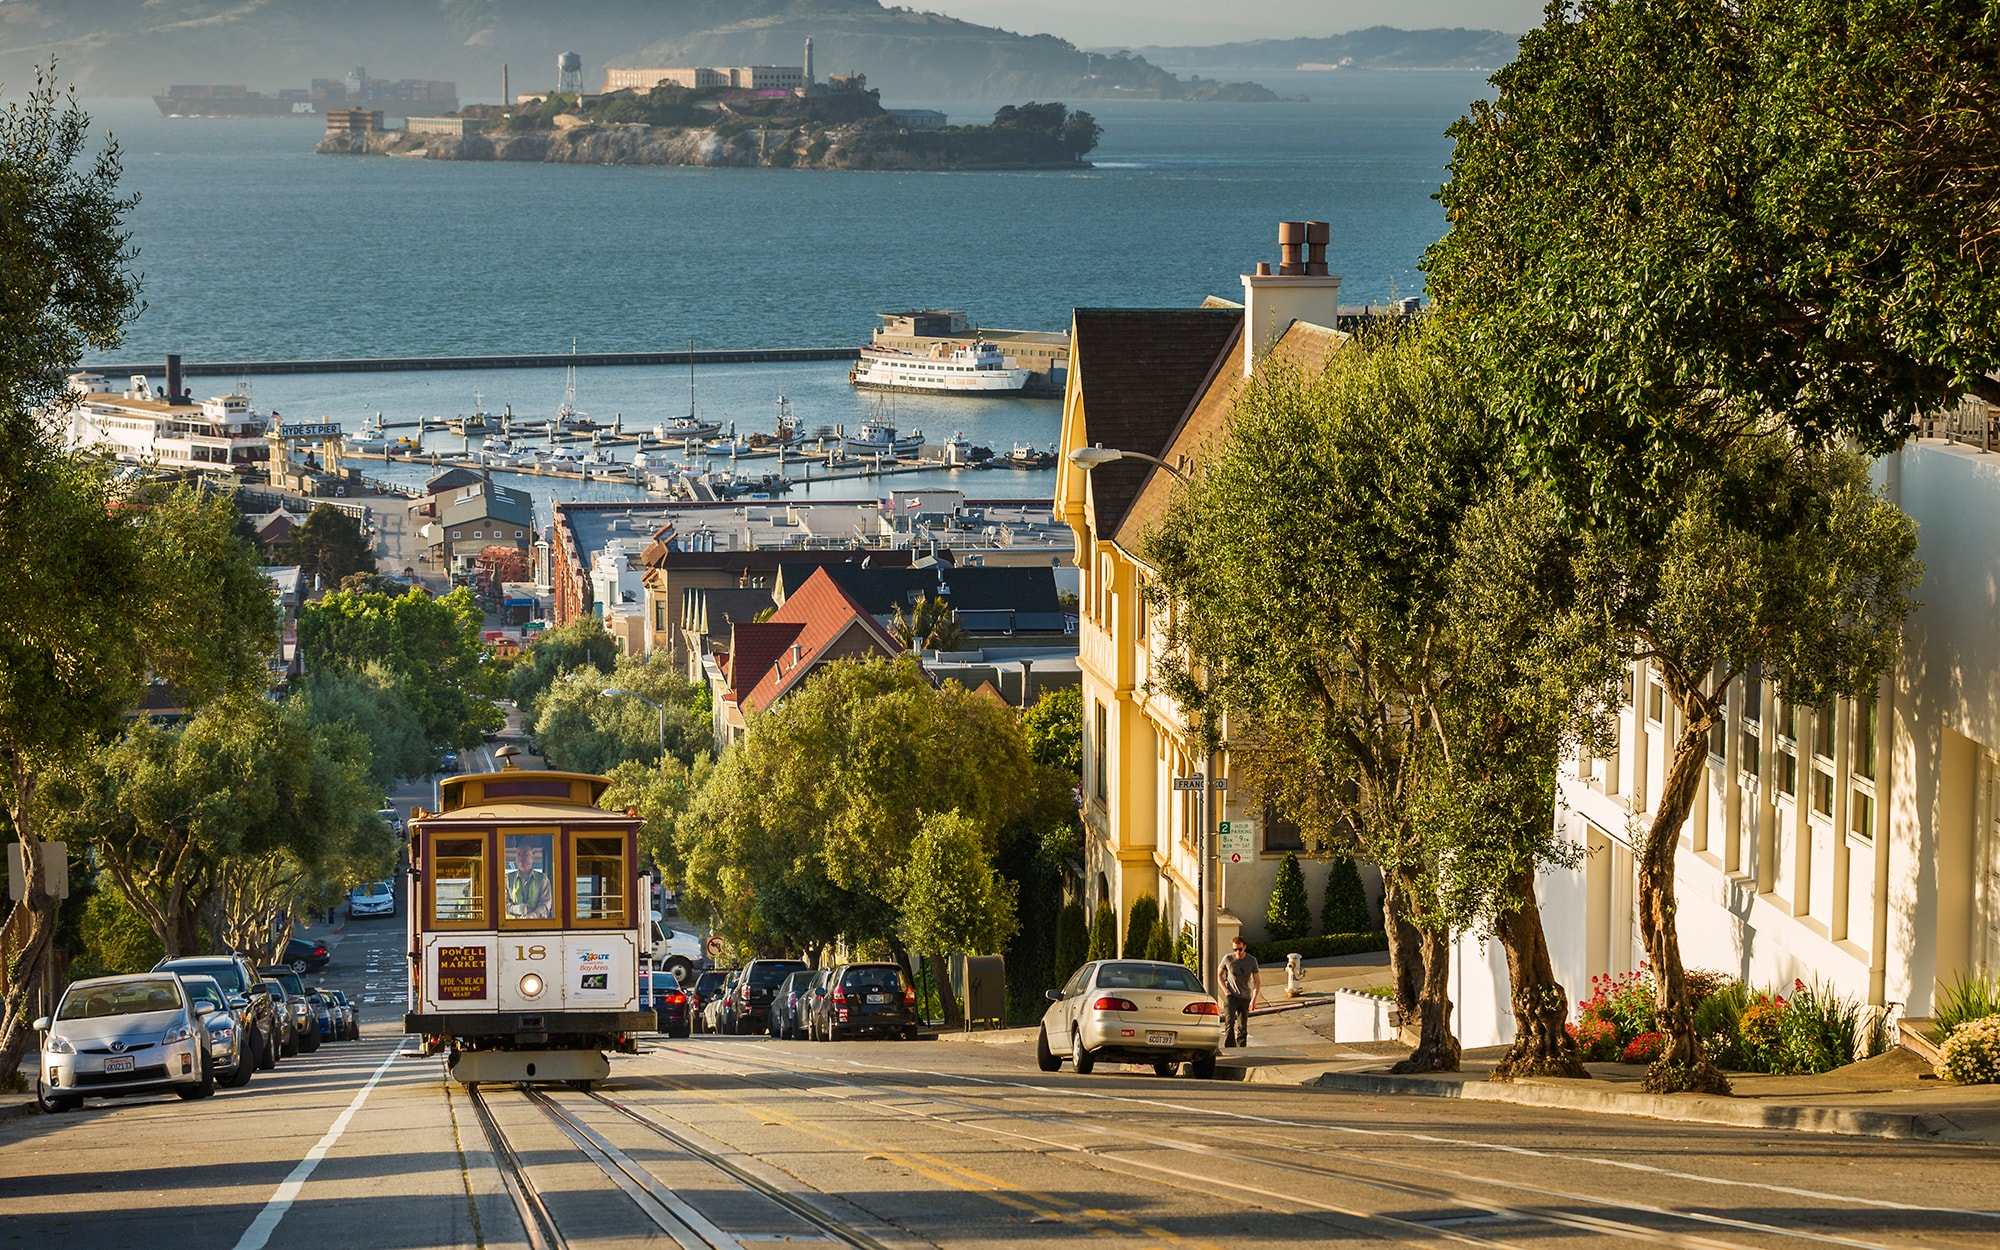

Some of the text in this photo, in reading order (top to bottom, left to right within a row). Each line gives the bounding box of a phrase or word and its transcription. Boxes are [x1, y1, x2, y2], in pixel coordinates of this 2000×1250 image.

[292, 102, 316, 113] APL
[282, 426, 304, 435] HYDE
[318, 425, 337, 434] PIER
[1178, 780, 1224, 788] FRANCO
[1221, 823, 1229, 833] 2
[441, 948, 485, 956] POWELL
[515, 944, 547, 961] 18
[441, 960, 486, 968] MARKET
[579, 964, 592, 972] Bay
[440, 977, 456, 985] HYDE
[464, 976, 485, 985] BEACH
